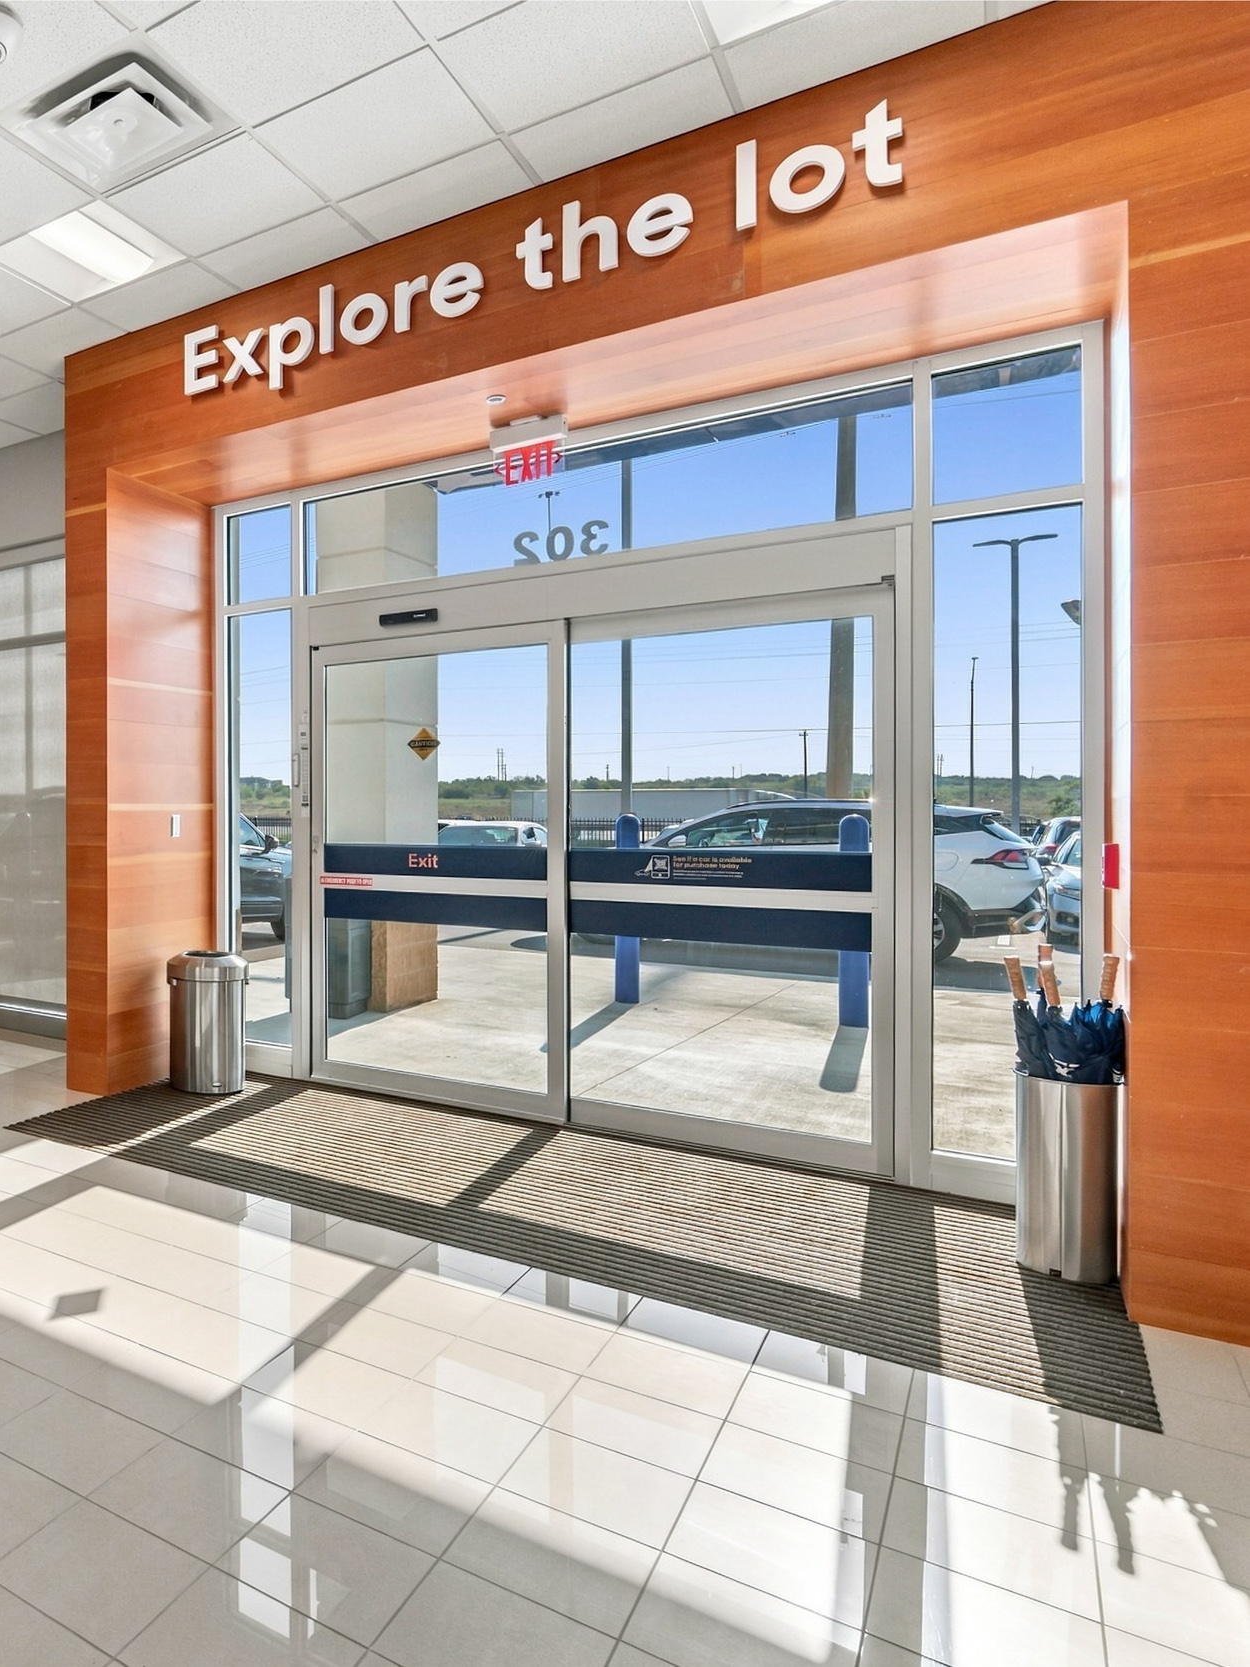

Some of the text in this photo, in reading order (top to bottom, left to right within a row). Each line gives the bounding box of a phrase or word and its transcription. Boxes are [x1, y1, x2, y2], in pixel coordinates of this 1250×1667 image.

[183, 99, 905, 396] Explore the lot
[504, 440, 557, 486] EXIT
[408, 853, 438, 869] Exit
